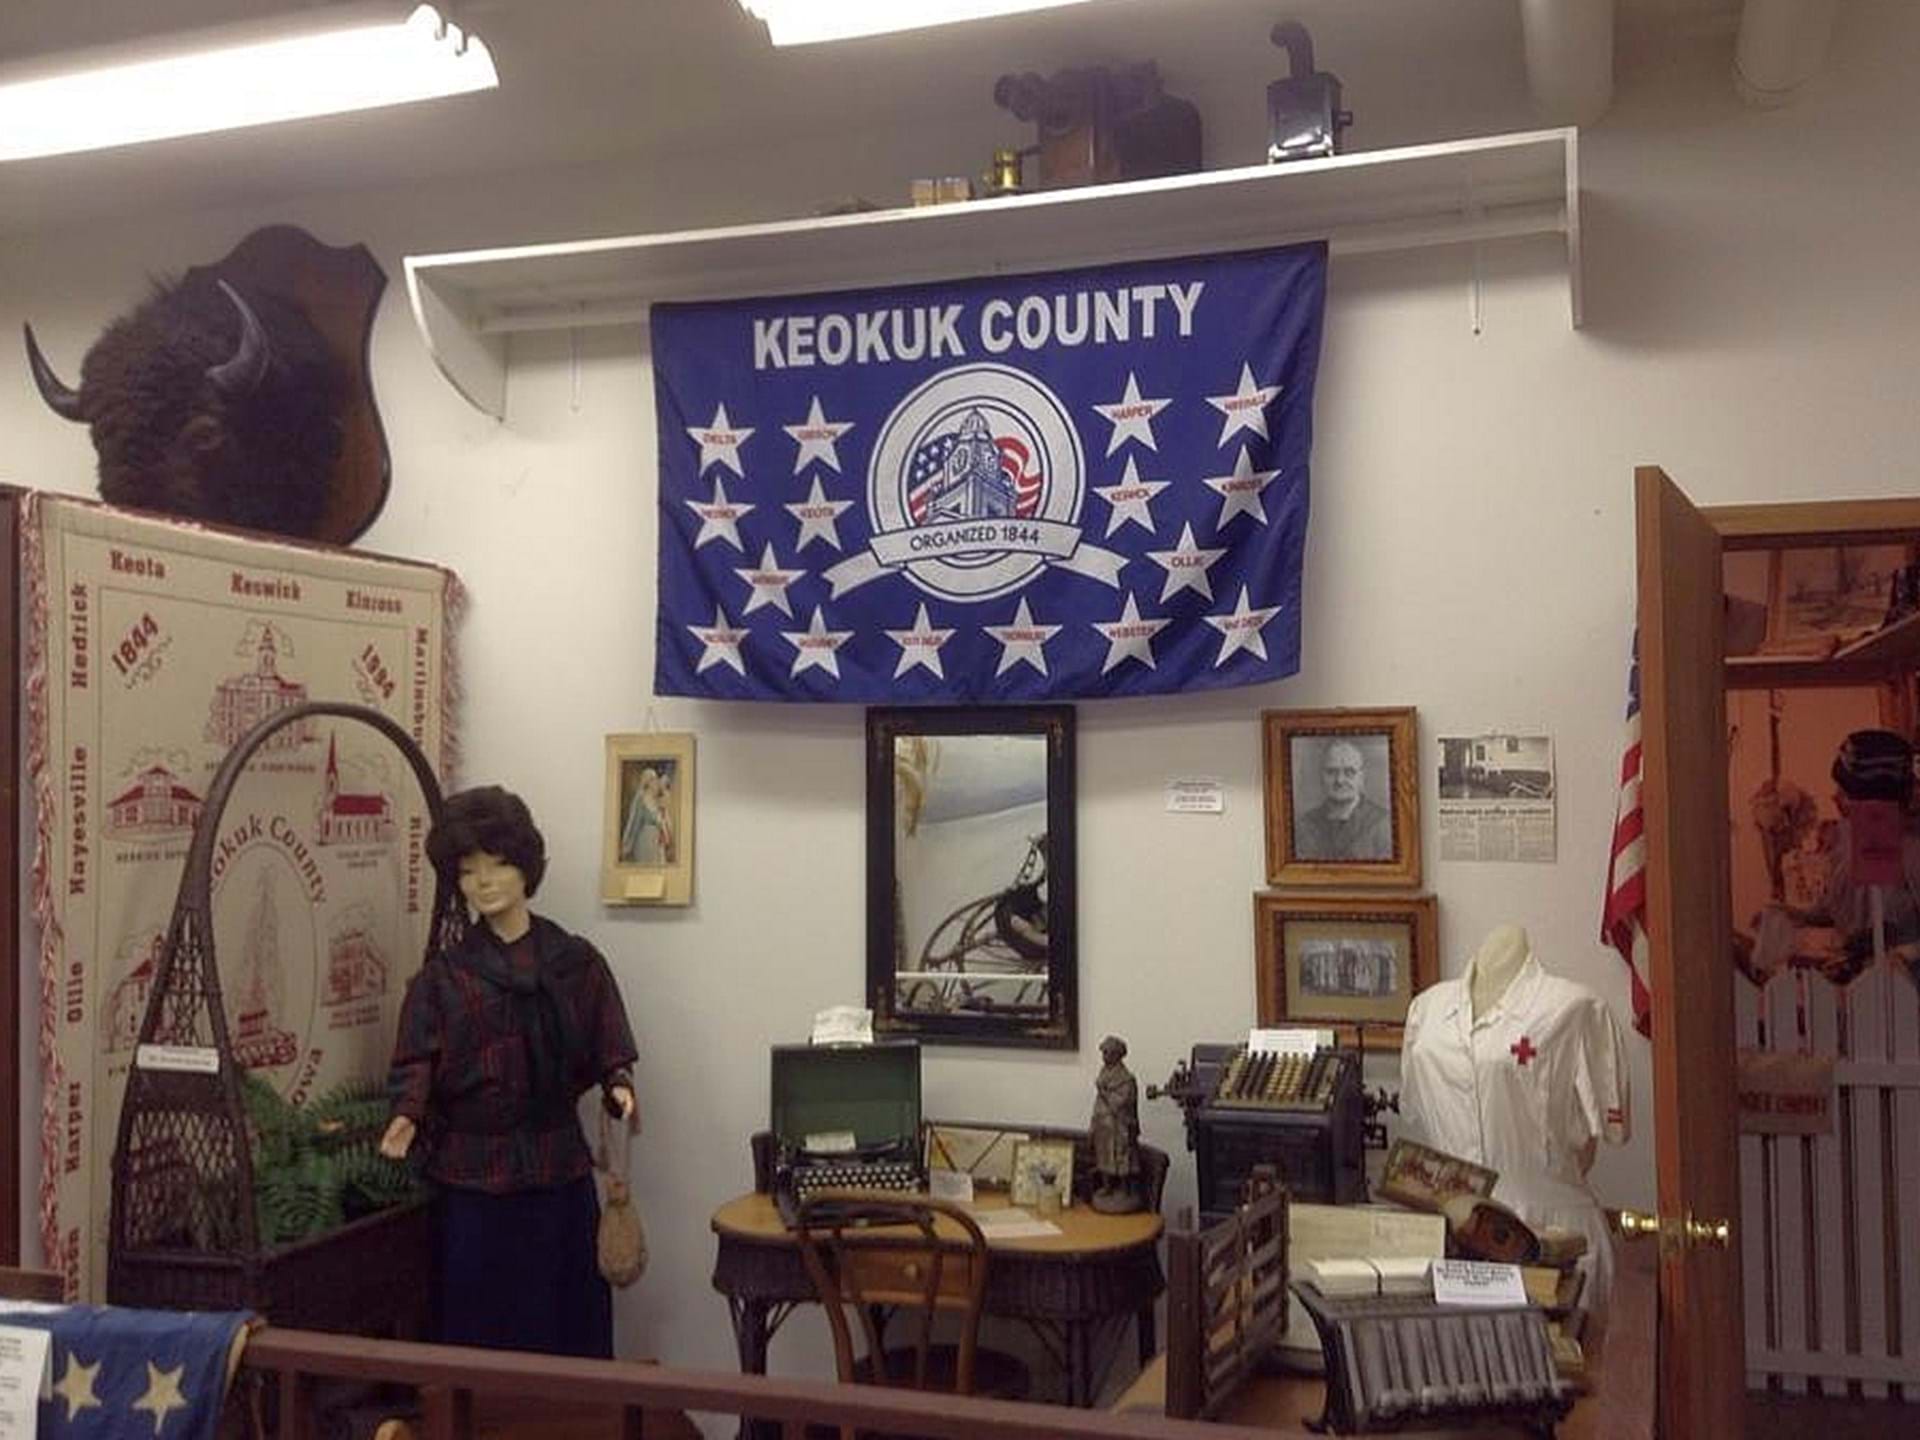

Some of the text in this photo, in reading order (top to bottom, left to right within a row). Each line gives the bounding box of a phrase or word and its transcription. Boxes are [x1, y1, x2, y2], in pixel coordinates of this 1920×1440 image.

[754, 282, 1206, 370] KEOKUK COUNTY
[109, 550, 166, 579] Keota
[910, 526, 1039, 551] ORGANIZED 1844
[230, 572, 301, 601] Keswick
[346, 590, 402, 614] Kinross
[70, 583, 88, 690] Hedrick
[110, 612, 159, 676] 1844
[414, 628, 428, 746] Martinsbu
[69, 746, 89, 896] Hayesville
[211, 814, 327, 905] okuk County
[67, 961, 83, 1024] Ollie
[292, 1048, 323, 1106] owa
[65, 1081, 82, 1174] Harper
